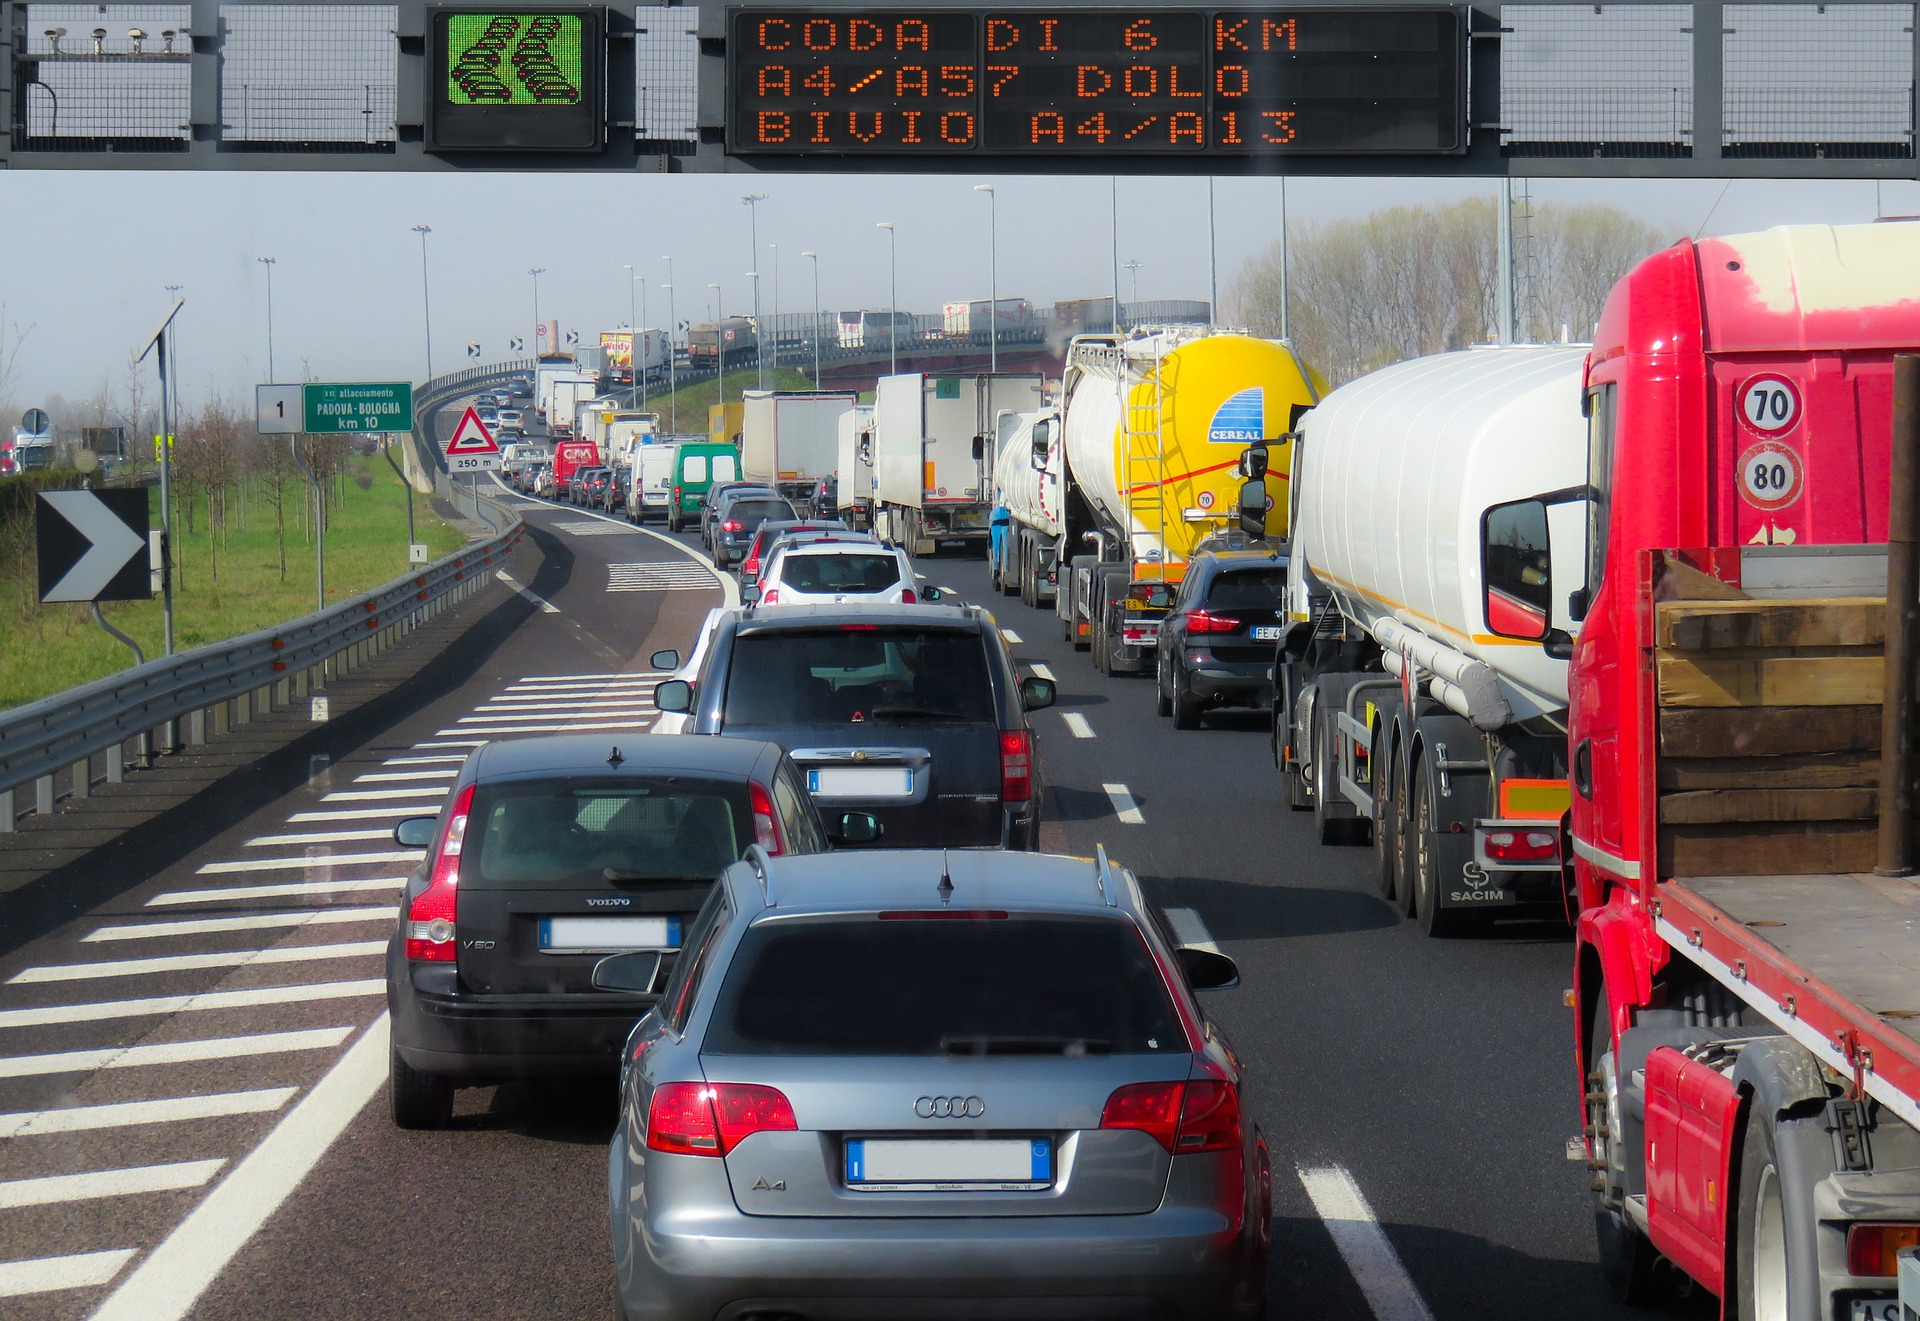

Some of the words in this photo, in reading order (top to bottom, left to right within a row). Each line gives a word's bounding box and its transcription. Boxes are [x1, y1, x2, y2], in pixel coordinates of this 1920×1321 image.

[759, 19, 929, 51] CODA
[987, 19, 1058, 51] DI
[1124, 19, 1158, 51] 6
[1216, 18, 1296, 51] KM
[758, 65, 1019, 97] A4/A57
[1077, 65, 1249, 97] DOLO
[758, 111, 974, 143] BIVIO
[1031, 111, 1296, 144] A4/A13
[603, 342, 630, 352] Wudy
[339, 389, 394, 398] allacciamento
[276, 401, 284, 418] 1
[1752, 389, 1789, 421] 70
[338, 417, 358, 429] km
[364, 416, 379, 428] 10
[1211, 430, 1260, 440] CEREAL
[458, 459, 478, 468] 250
[1753, 463, 1786, 490] 80
[1201, 496, 1210, 504] 70
[1257, 628, 1269, 638] FE
[586, 898, 631, 906] VOLVO
[1450, 890, 1504, 902] SACIM
[752, 1175, 787, 1191] A4
